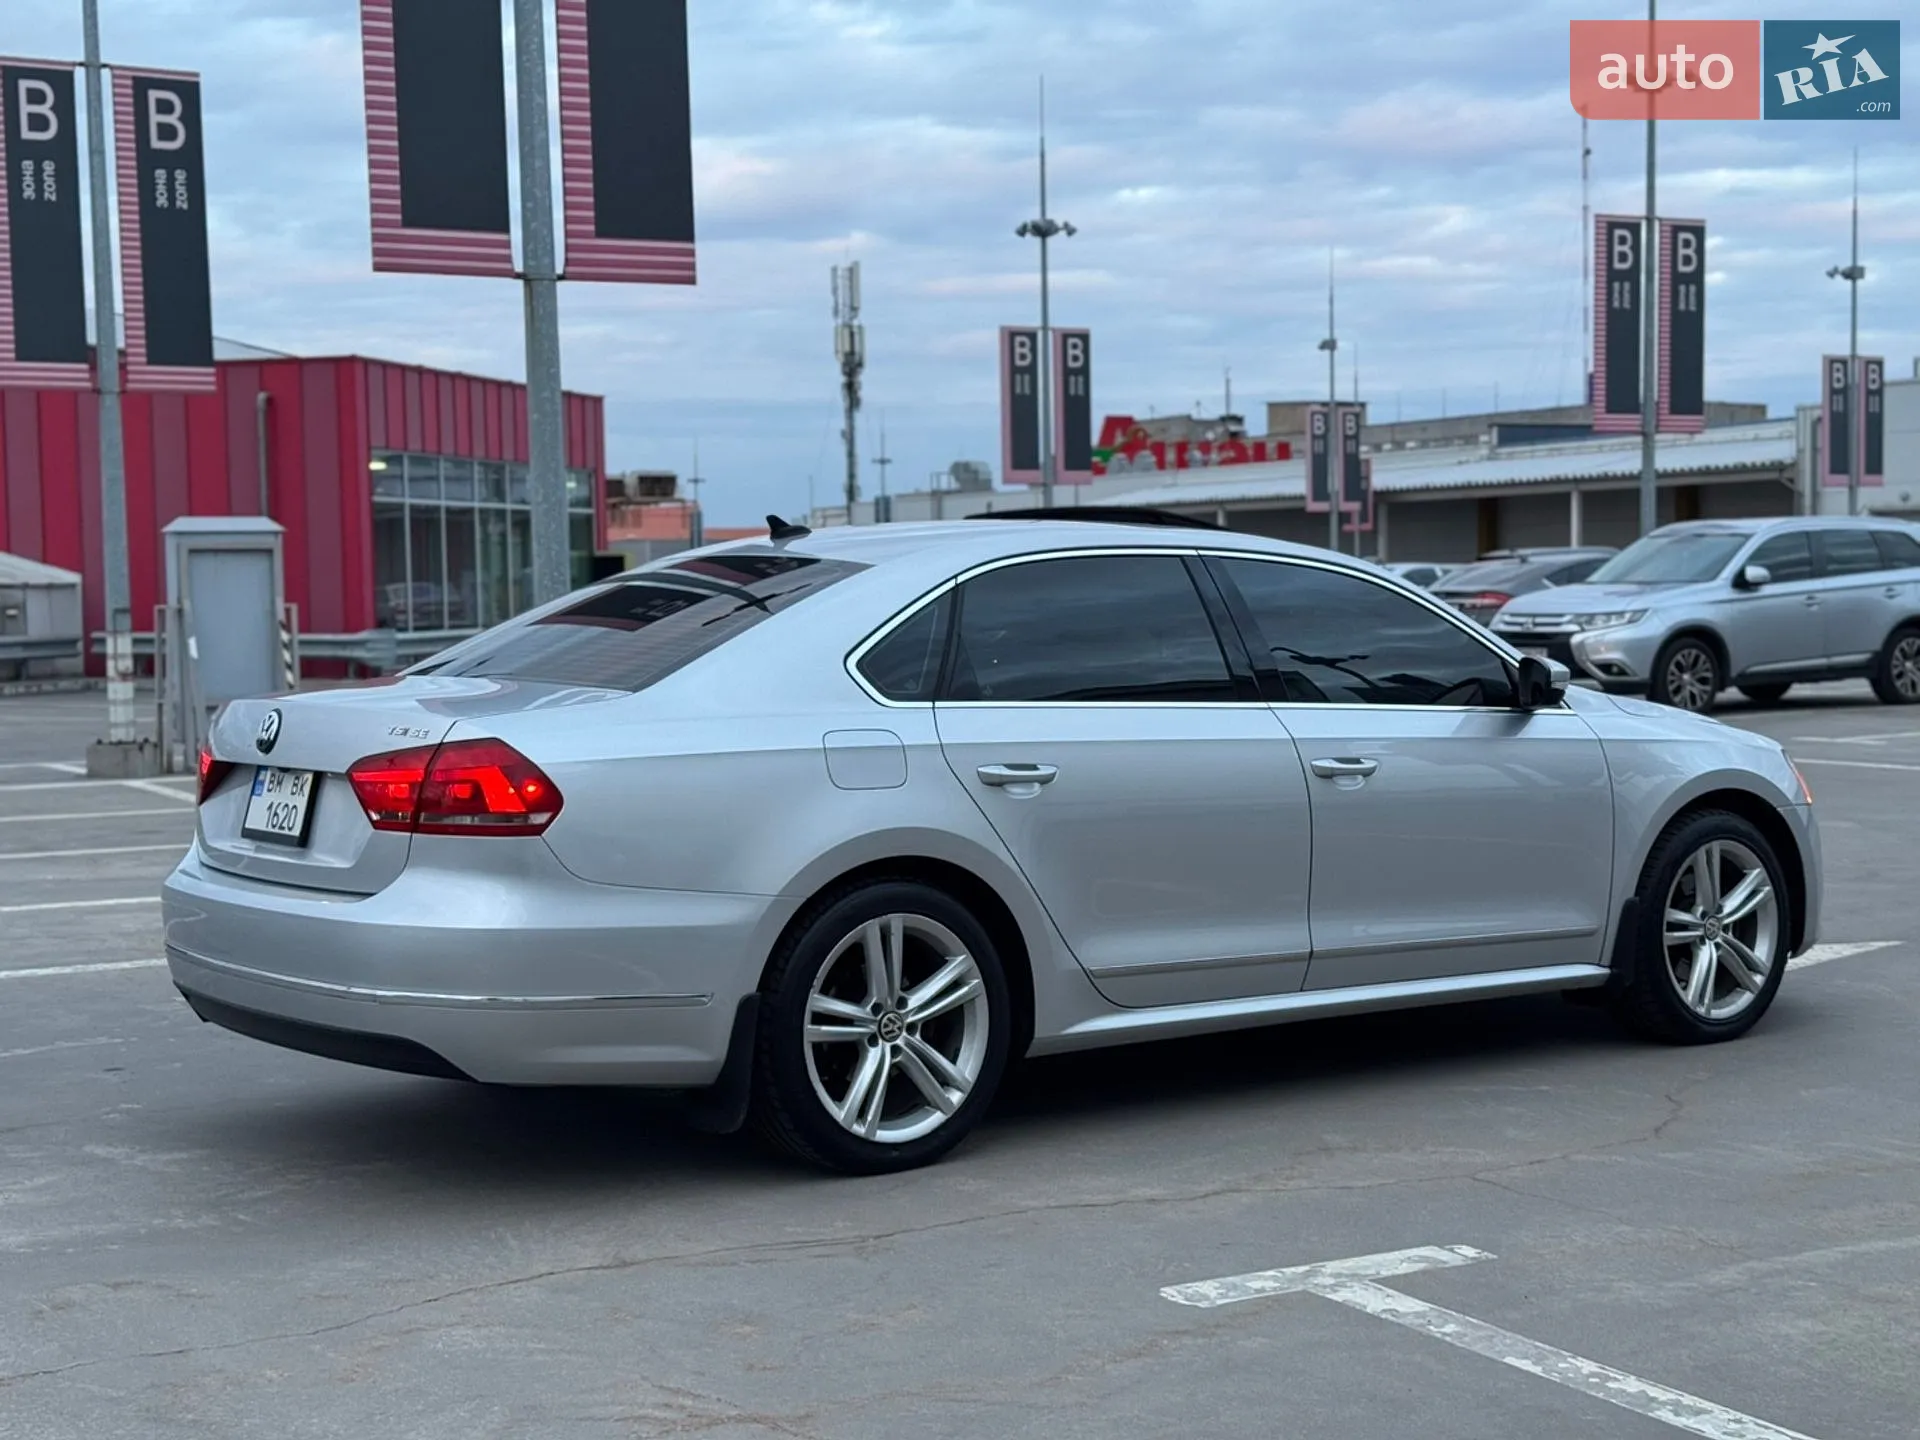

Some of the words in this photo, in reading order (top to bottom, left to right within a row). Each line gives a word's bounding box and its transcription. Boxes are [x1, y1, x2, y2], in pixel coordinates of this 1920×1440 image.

[18, 78, 58, 141] B
[148, 89, 186, 150] B
[21, 160, 36, 201] зона
[42, 160, 57, 202] zone
[154, 168, 169, 209] зона
[174, 169, 189, 211] zone
[1613, 228, 1633, 270] B
[1677, 231, 1698, 273] B
[1014, 336, 1032, 367] B
[1067, 337, 1084, 368] B
[1832, 362, 1845, 389] B
[1868, 363, 1880, 390] B
[265, 801, 299, 832] 1620
